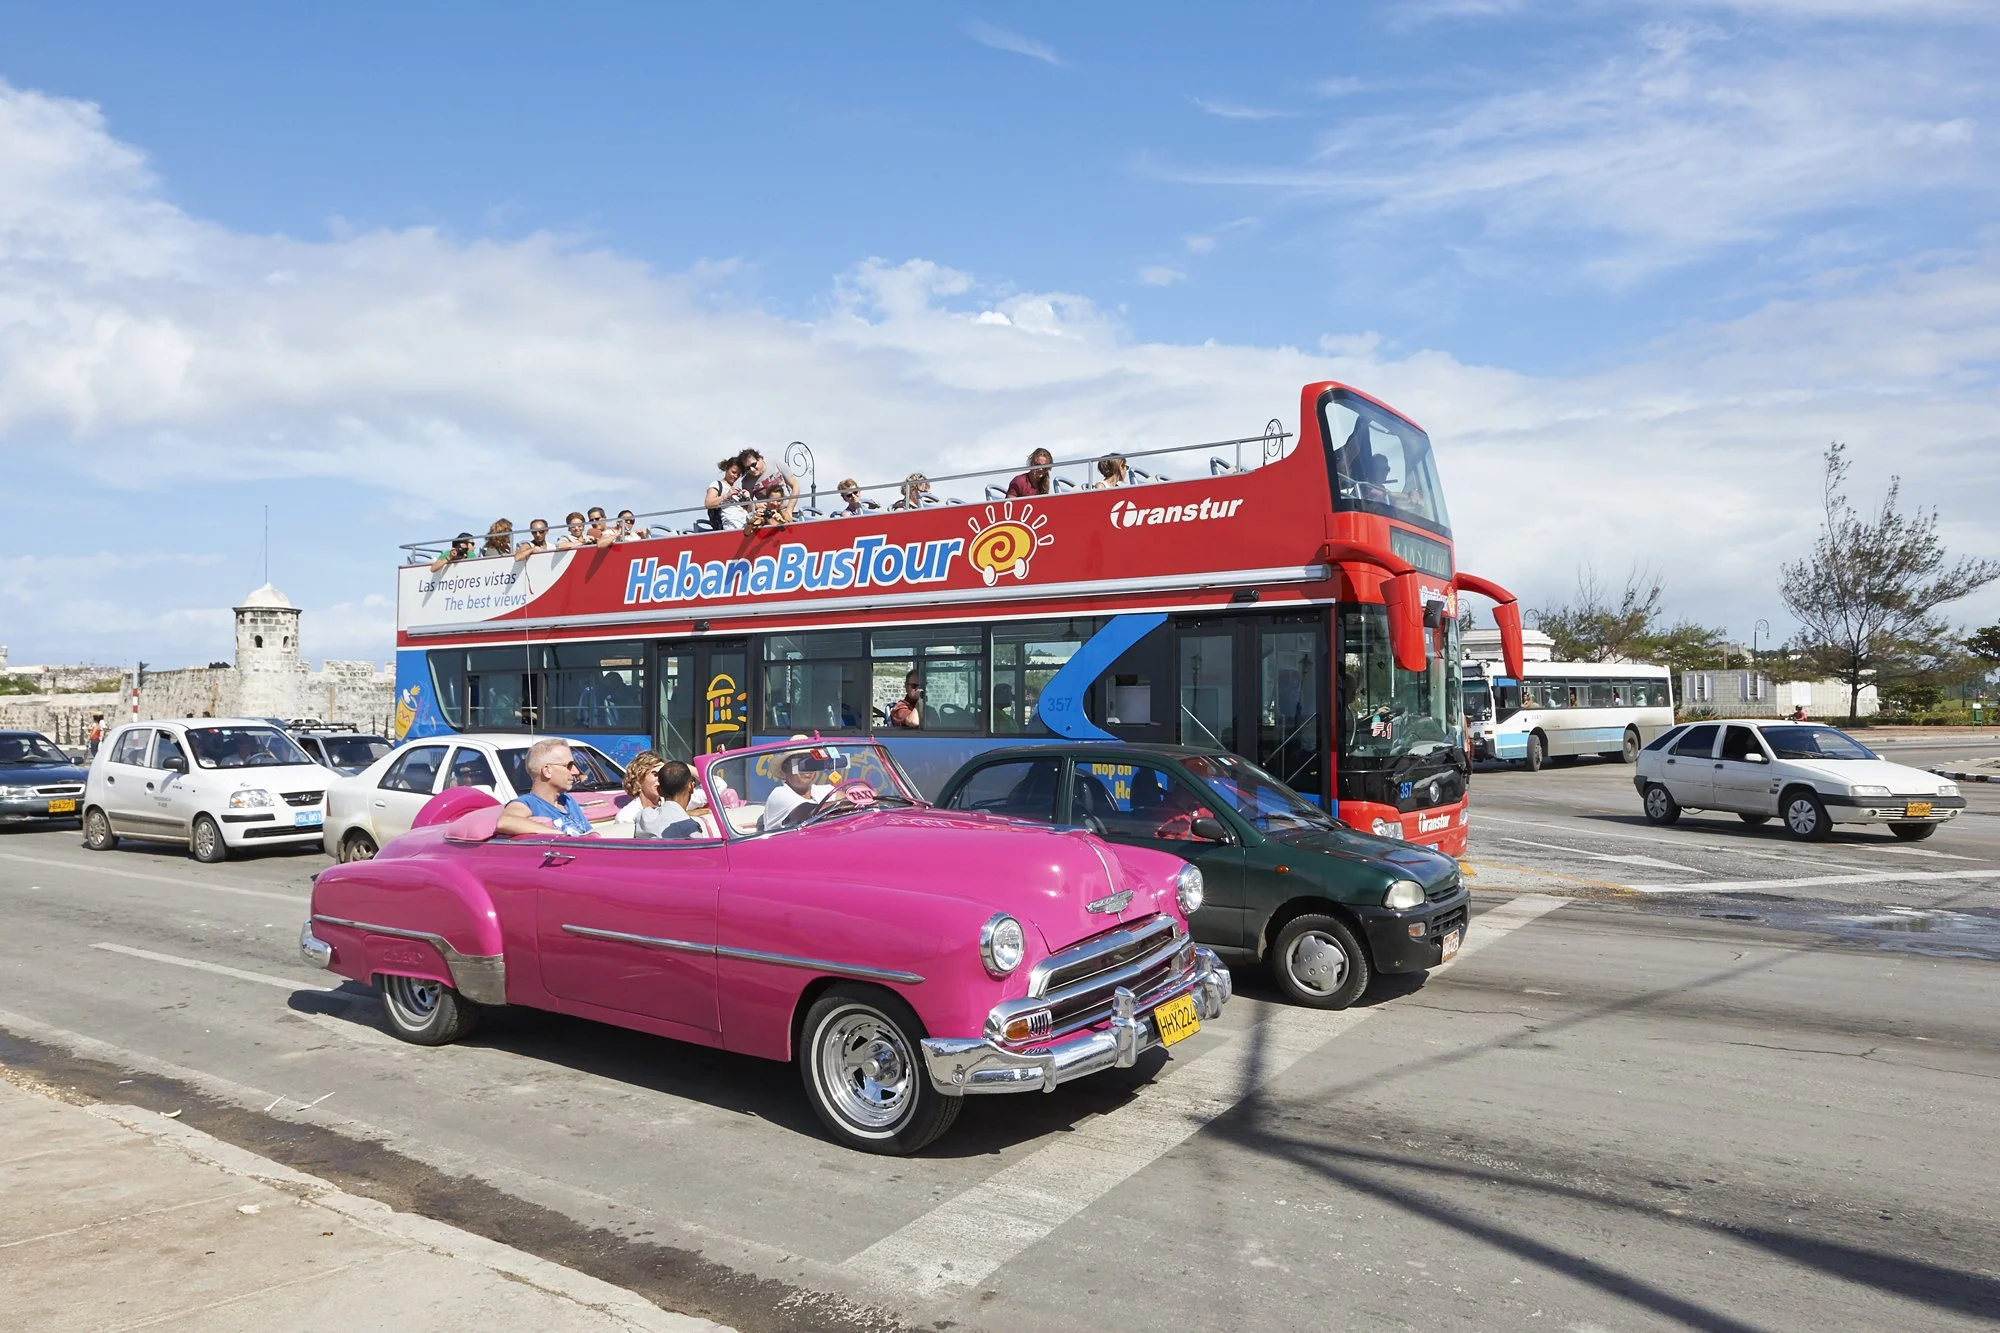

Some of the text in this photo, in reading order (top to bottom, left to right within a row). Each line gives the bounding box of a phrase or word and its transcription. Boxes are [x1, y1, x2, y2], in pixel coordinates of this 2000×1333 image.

[1110, 497, 1244, 529] Transtur
[624, 534, 964, 605] HabanaBusTour
[418, 571, 517, 593] Las mejores vistas
[444, 592, 527, 611] The best views
[1047, 697, 1073, 712] 357
[849, 789, 874, 801] TAXI
[1115, 780, 1131, 799] Ho
[1400, 781, 1413, 799] 357
[1159, 1004, 1197, 1038] HHX224
